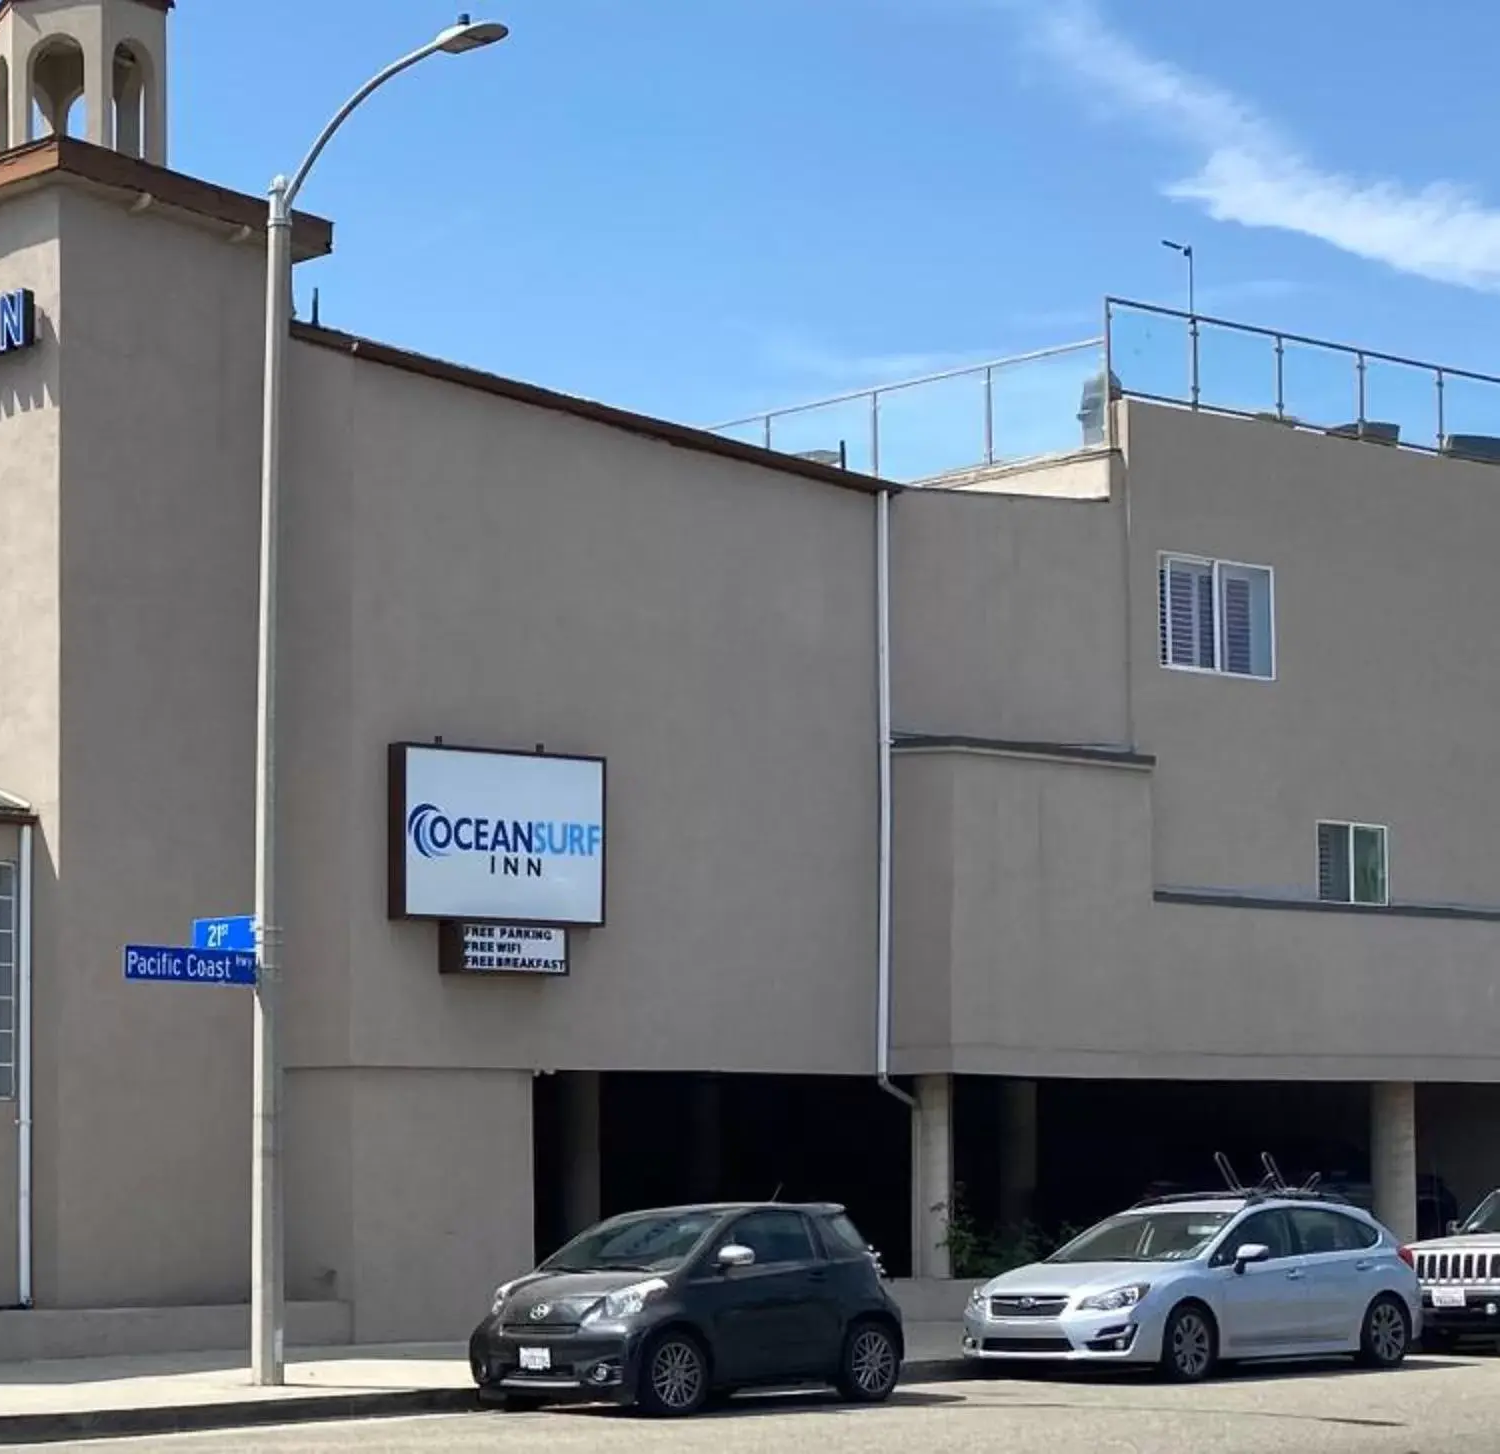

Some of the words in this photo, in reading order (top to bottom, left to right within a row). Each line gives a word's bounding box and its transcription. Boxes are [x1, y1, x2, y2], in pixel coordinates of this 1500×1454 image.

[490, 855, 542, 877] INN
[465, 927, 495, 938] FREE
[500, 927, 552, 941] PARKING
[464, 941, 495, 953] FREE
[497, 943, 521, 955] WIFI
[127, 951, 182, 976] Pacific
[187, 954, 231, 978] Coast
[464, 955, 495, 967] FREE
[496, 957, 565, 971] BREAKFAST
